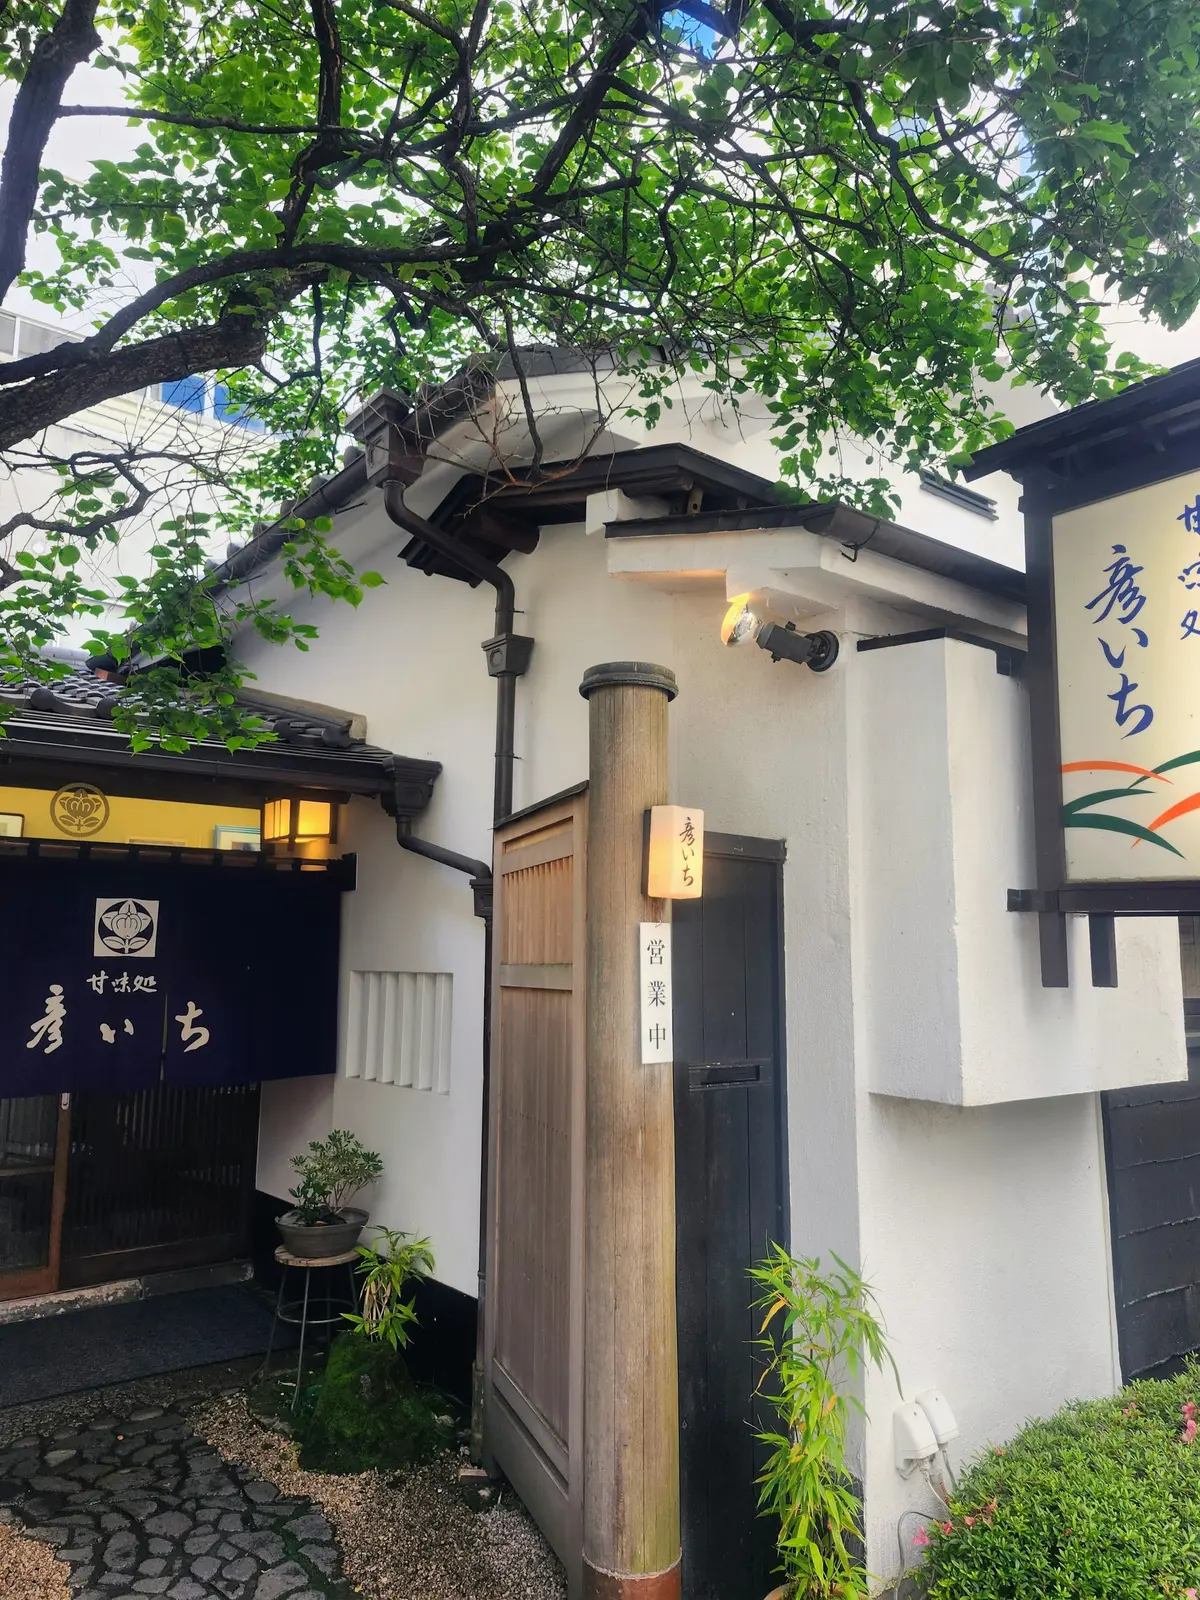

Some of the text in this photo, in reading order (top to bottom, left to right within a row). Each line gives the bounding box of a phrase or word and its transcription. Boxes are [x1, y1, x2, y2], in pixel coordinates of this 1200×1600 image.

[1086, 544, 1153, 739] 彦いち
[679, 816, 695, 887] 彦いち
[86, 970, 157, 994] 甘味処
[647, 939, 666, 1050] 営業中
[26, 984, 210, 1053] 彦いち
